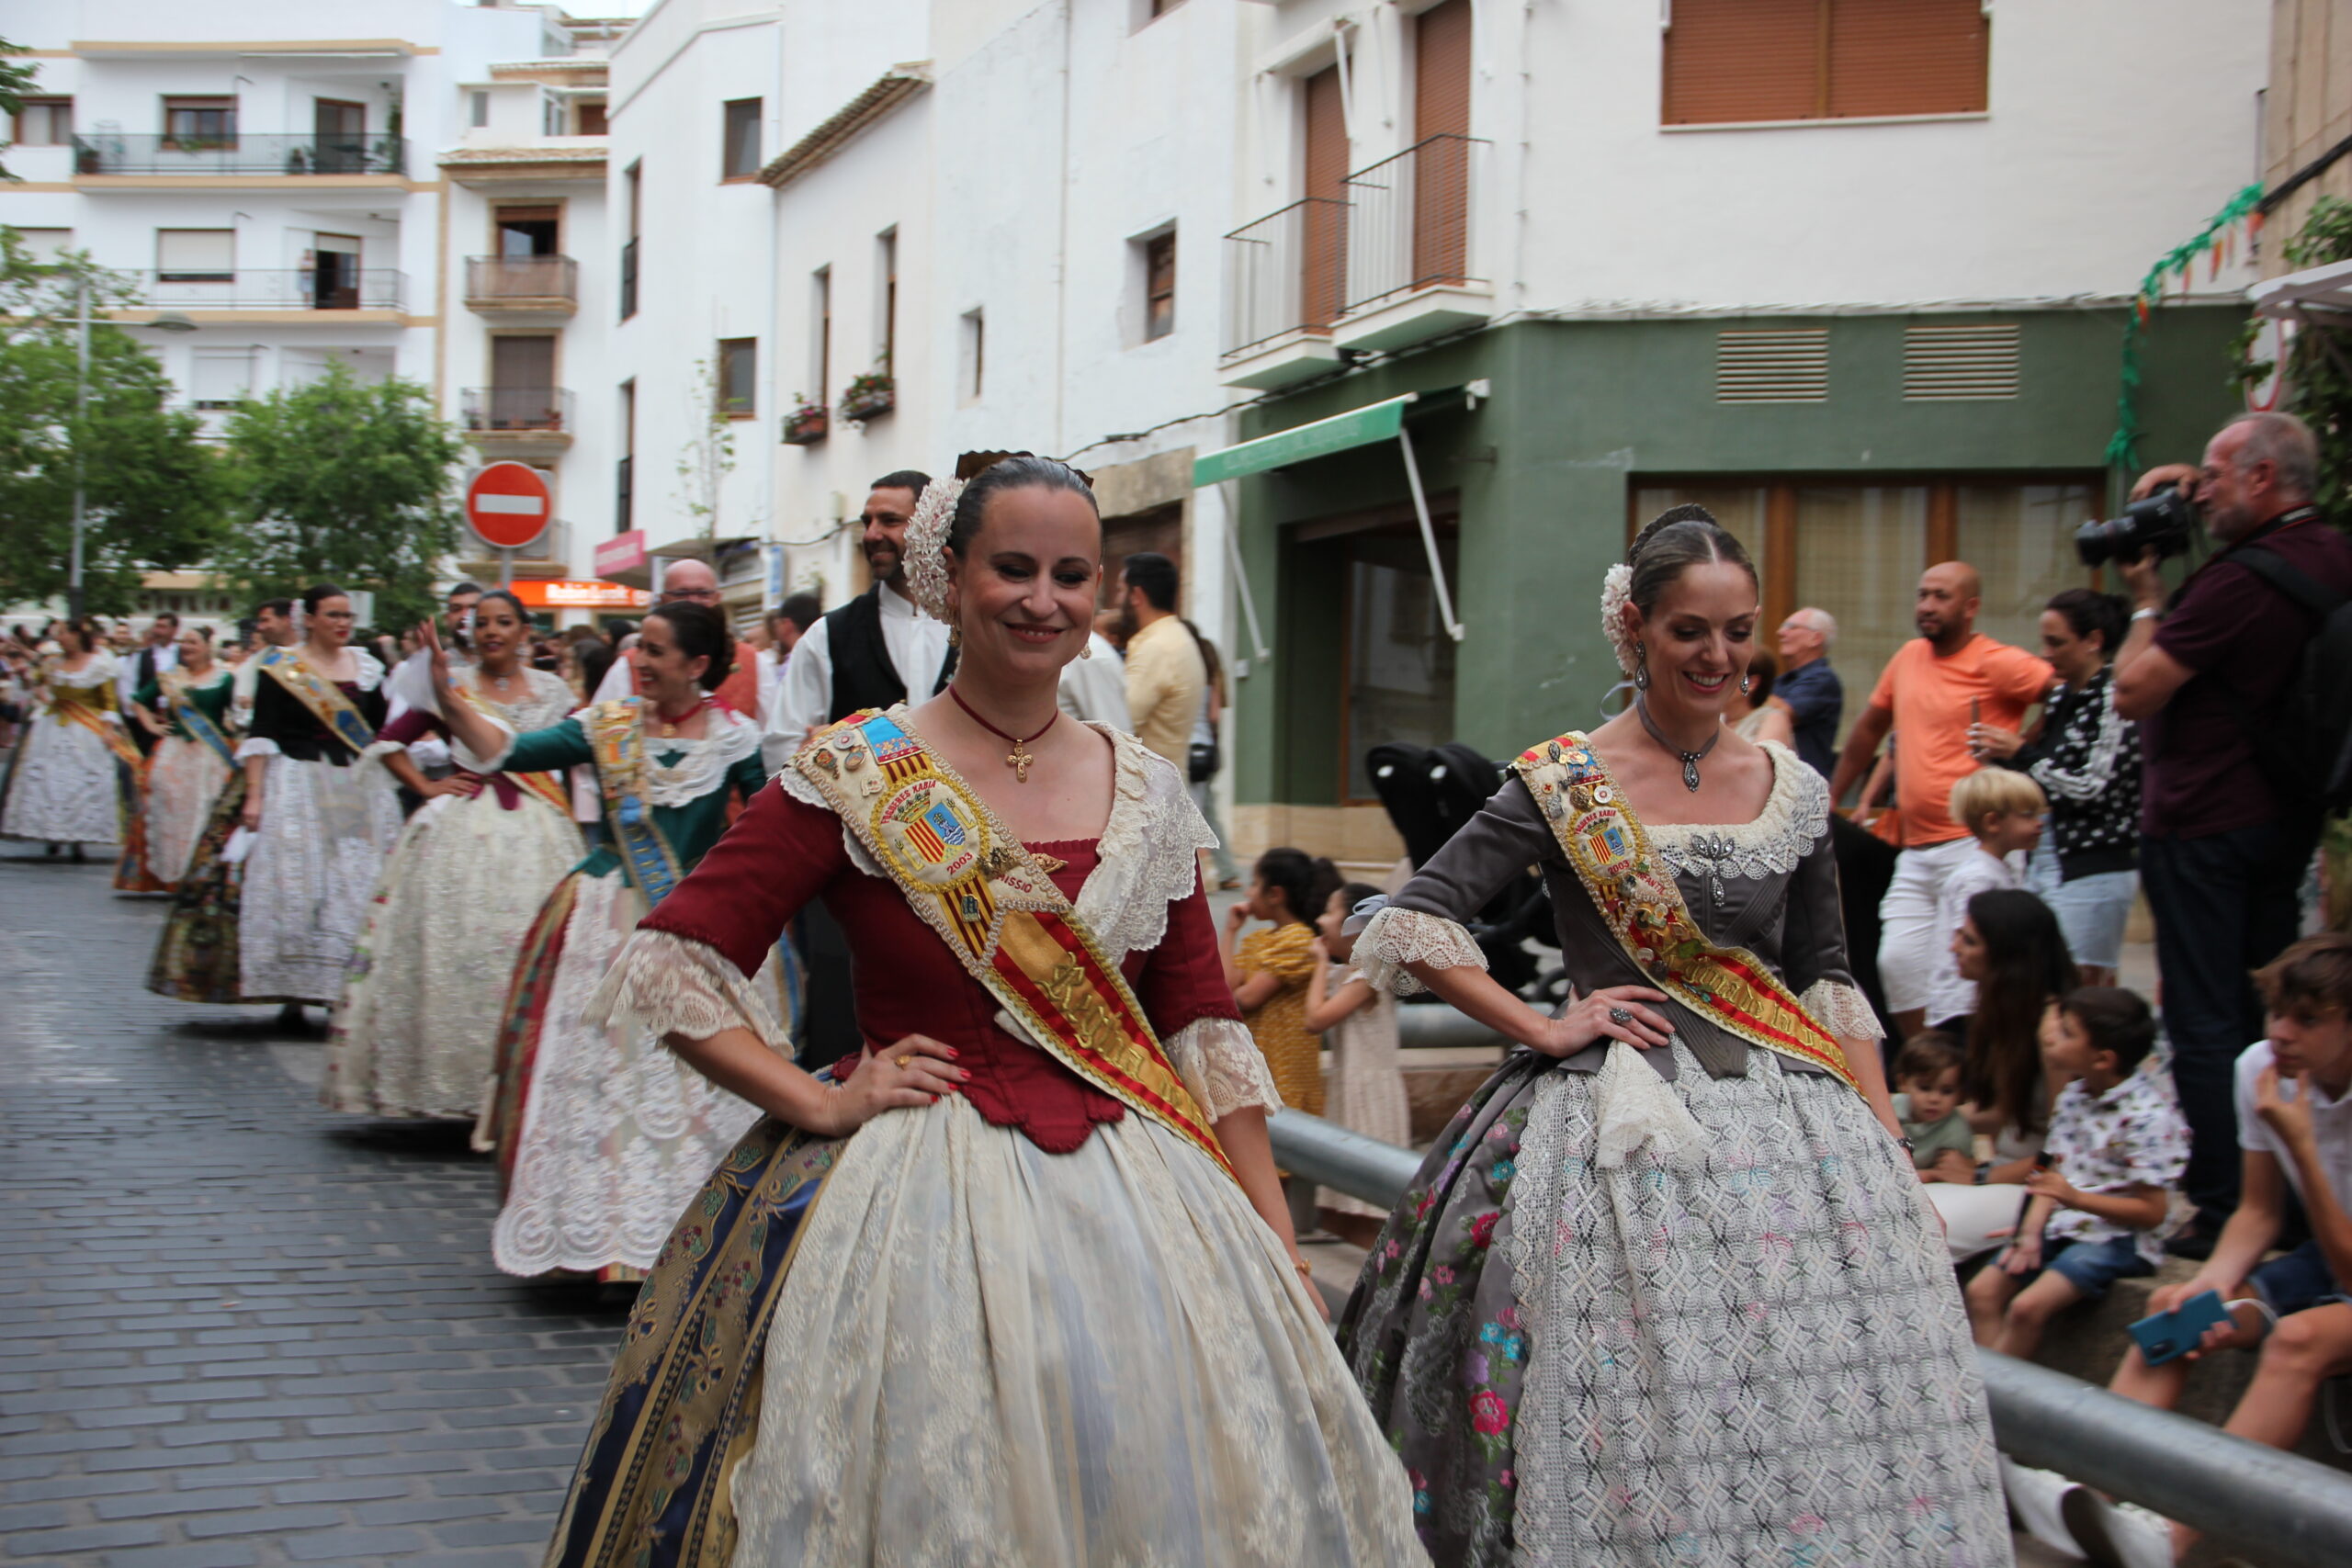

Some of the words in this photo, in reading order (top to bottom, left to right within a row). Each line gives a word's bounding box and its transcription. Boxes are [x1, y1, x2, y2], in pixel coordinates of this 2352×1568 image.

[880, 789, 911, 824] FOGUERES
[912, 780, 936, 794] XABIA
[946, 852, 974, 875] 2003
[1607, 860, 1630, 876] 2003
[1634, 870, 1667, 896] INFANTIL
[1770, 1002, 1792, 1035] la
